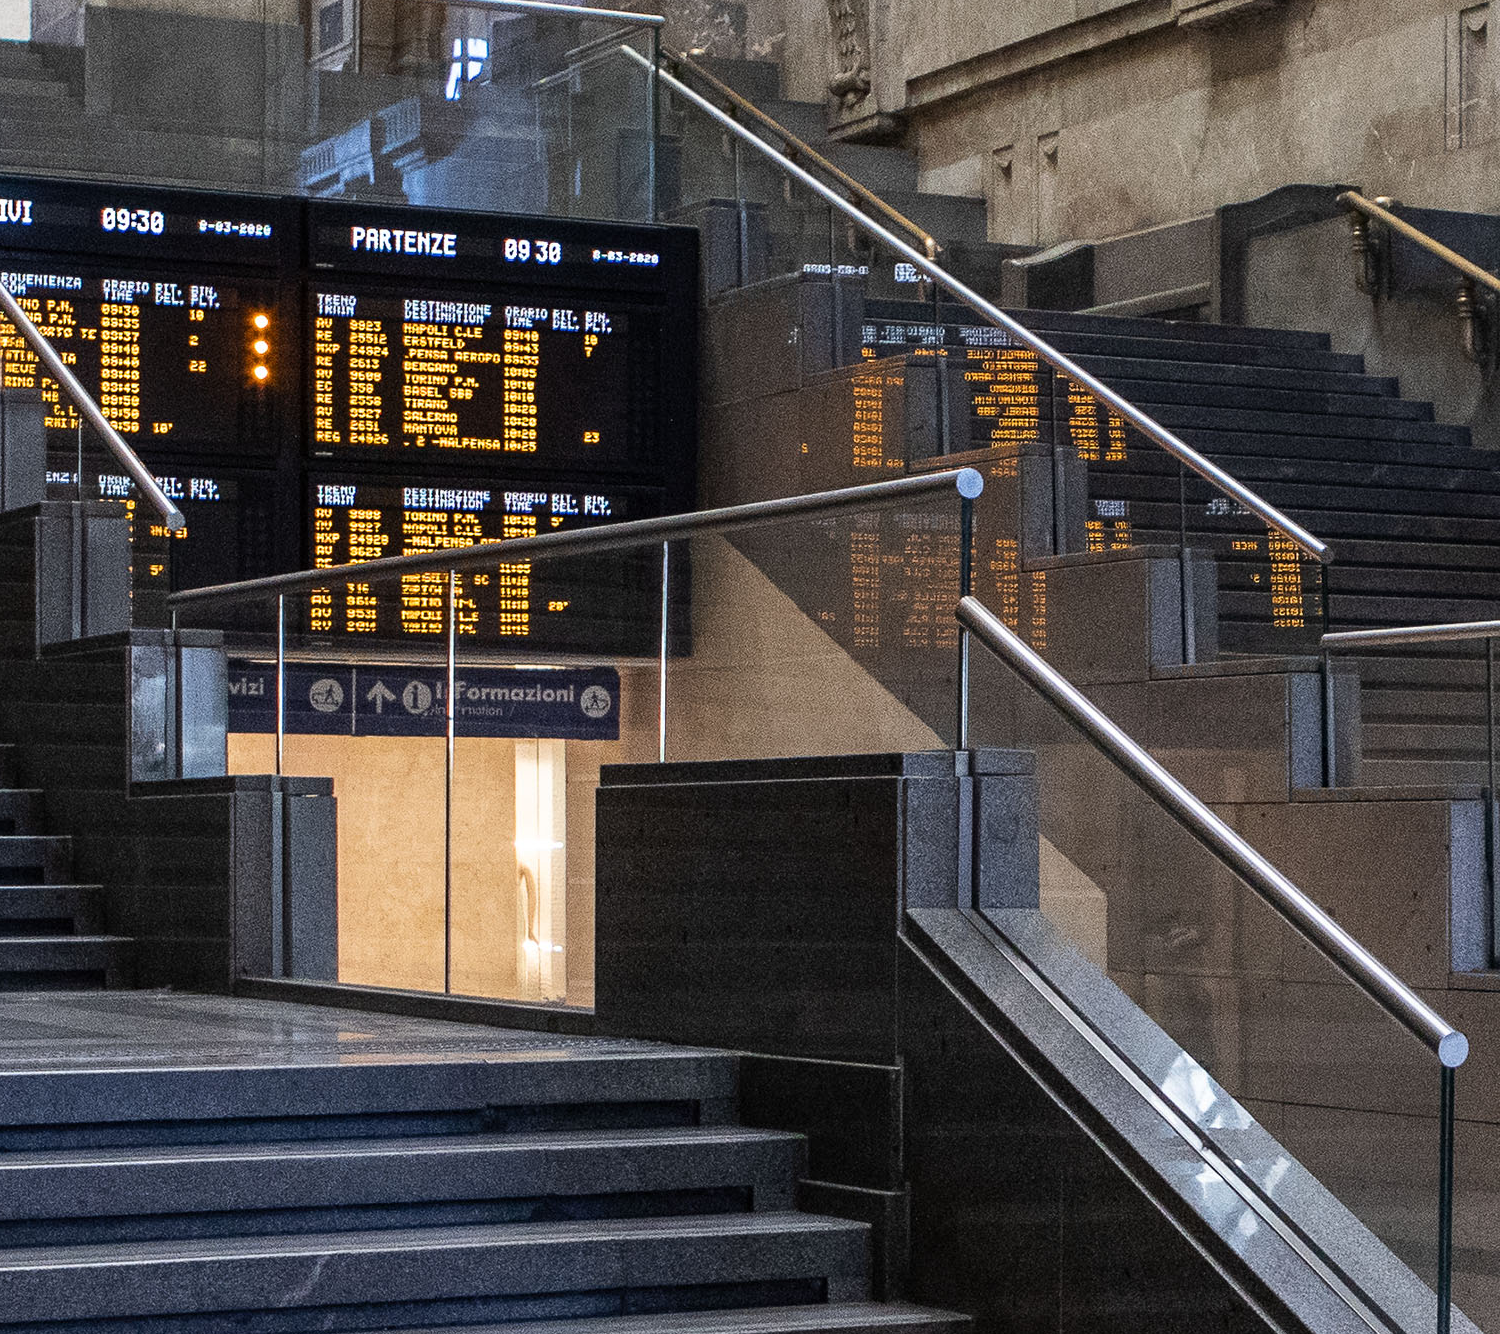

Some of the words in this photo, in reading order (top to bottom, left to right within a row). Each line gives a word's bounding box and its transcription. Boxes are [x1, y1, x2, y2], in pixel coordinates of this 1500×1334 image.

[101, 207, 165, 236] 09:30
[351, 226, 457, 257] PARTENZE
[103, 279, 150, 294] ORARIO
[155, 283, 182, 297] RIT.
[104, 290, 134, 302] TIME
[155, 292, 184, 306] DEL.
[47, 299, 74, 313] P.N.
[189, 309, 205, 322] 10
[317, 293, 358, 308] TRENO
[404, 299, 493, 317] DESTINAZIONE
[504, 306, 548, 320] ORARIO
[552, 309, 578, 323] RIT.
[585, 311, 611, 324] BIN.
[318, 303, 355, 317] TRAIN
[404, 308, 485, 326] DESTINATION
[506, 316, 534, 329] TIME
[552, 318, 580, 331] DEL.
[49, 313, 77, 326] P.N.
[189, 335, 199, 347] 2
[316, 317, 333, 328] AV
[403, 323, 448, 336] NAPOLI
[454, 325, 484, 339] C.LE
[584, 334, 598, 347] 10
[316, 330, 333, 341] RE
[349, 332, 388, 345] 25512
[403, 336, 467, 349] ERSTFELD
[584, 347, 593, 359] 7
[316, 342, 341, 354] MXP
[455, 351, 501, 364] AEROPO
[189, 361, 207, 373] 22
[316, 355, 333, 366] RE
[349, 357, 381, 369] 2613
[403, 361, 459, 374] BERGAMO
[504, 366, 538, 379] 10:05
[316, 368, 333, 379] AV
[404, 373, 449, 386] TORINO
[454, 376, 481, 389] P.N.
[504, 379, 536, 391] 10:10
[316, 380, 333, 392] EC
[403, 385, 443, 398] BASEL
[450, 388, 474, 400] SBB
[504, 391, 536, 403] 10:10
[316, 393, 333, 405] RE
[404, 398, 449, 410] TIRANO
[504, 403, 538, 415] 10:20
[109, 420, 140, 433] 9:50
[316, 405, 333, 417] AV
[403, 410, 458, 423] SALERNO
[504, 415, 538, 427] 10:20
[316, 418, 333, 430] RE
[349, 419, 381, 432] 2651
[403, 423, 459, 436] MANTOVA
[504, 428, 538, 440] 10:20
[583, 431, 600, 444] 23
[316, 431, 341, 443] REG
[504, 440, 538, 452] 10:25
[100, 484, 129, 497] TIME
[317, 485, 357, 498] TRENO
[404, 487, 491, 503] DESTINAZIONE
[504, 492, 547, 505] ORARIO
[552, 494, 577, 506] RIT.
[317, 494, 355, 506] TRAIN
[404, 498, 484, 511] DESTINATION
[505, 501, 533, 514] TIME
[552, 503, 579, 515] DEL.
[315, 508, 333, 519] AV
[403, 511, 449, 524] TORINO
[453, 513, 480, 525] P.N.
[315, 533, 341, 544] MXP
[404, 535, 474, 549] -MALPENSA
[315, 545, 333, 556] AV
[309, 595, 333, 605] AV
[309, 607, 333, 618] AV
[228, 677, 264, 695] vizi
[436, 680, 575, 703] Iformazioni
